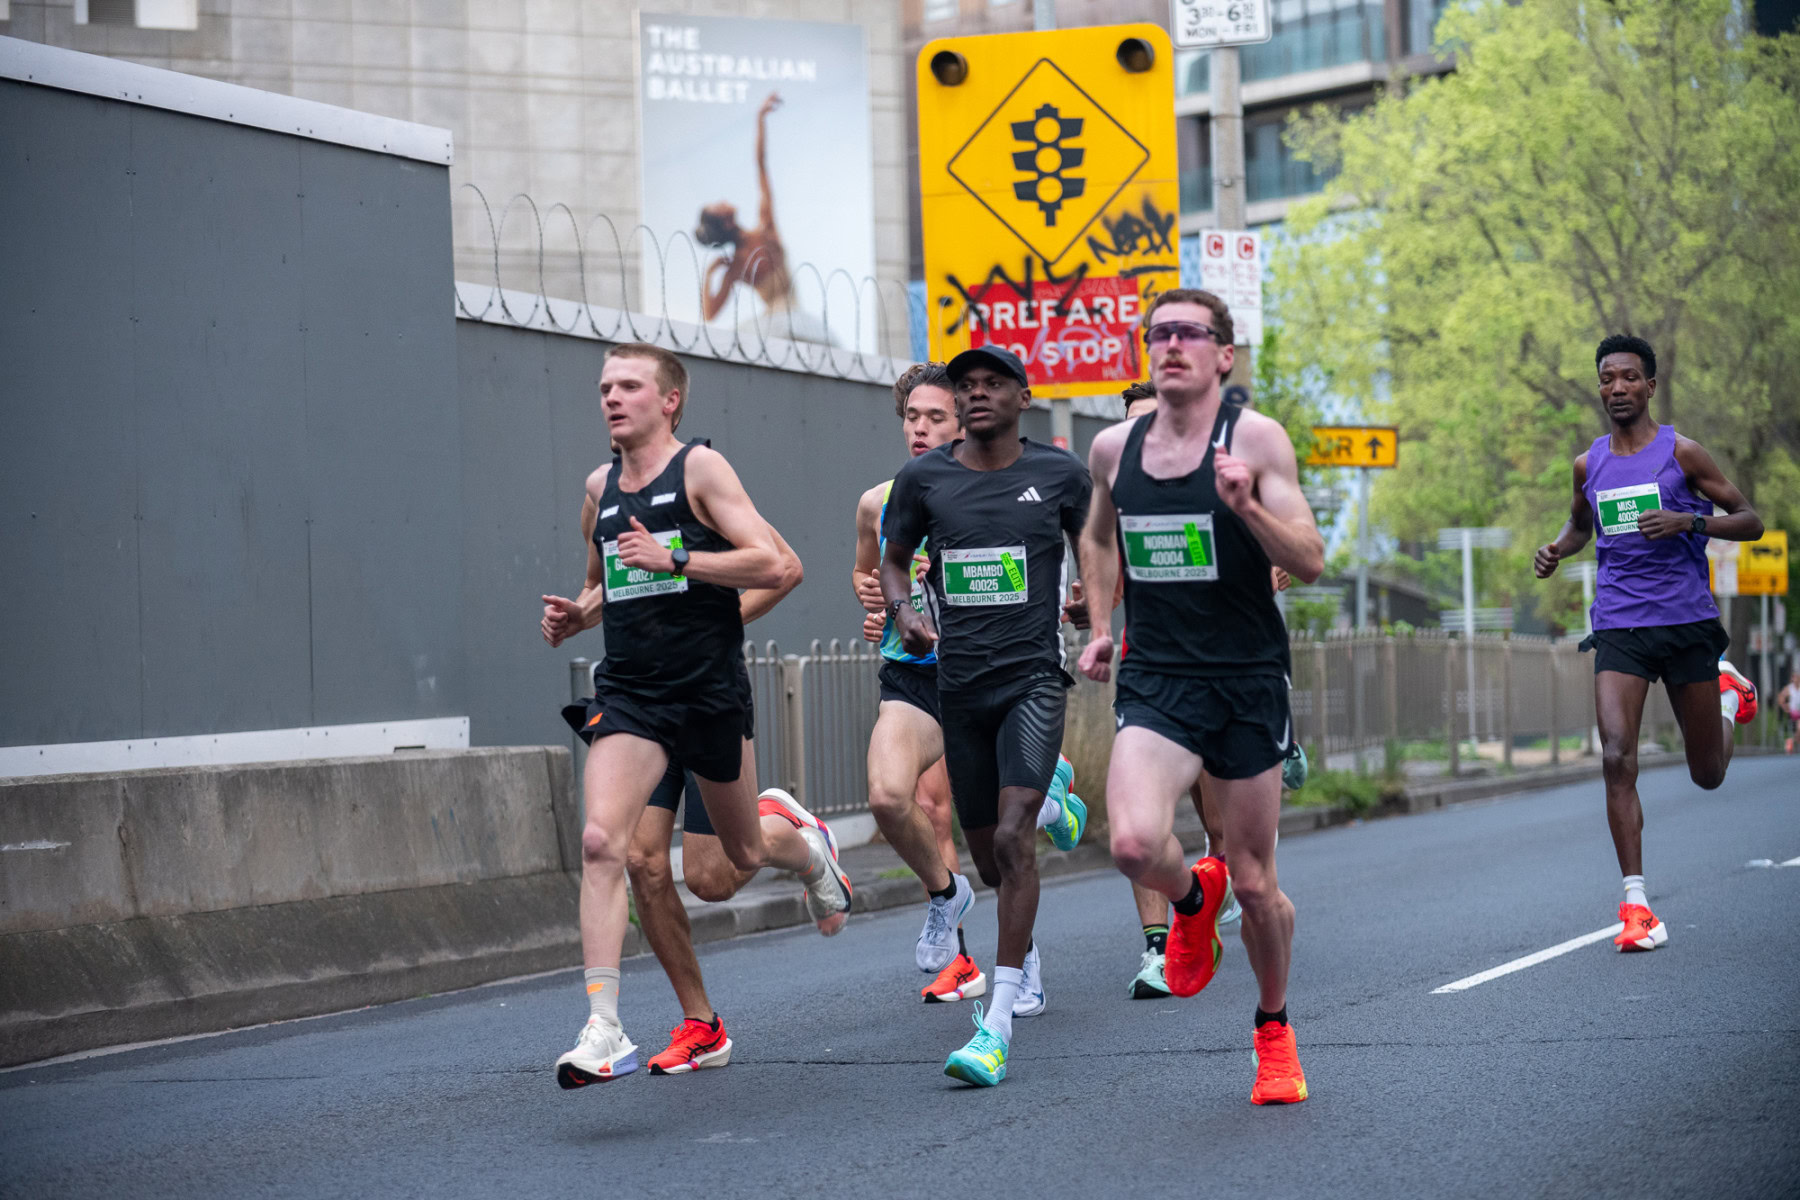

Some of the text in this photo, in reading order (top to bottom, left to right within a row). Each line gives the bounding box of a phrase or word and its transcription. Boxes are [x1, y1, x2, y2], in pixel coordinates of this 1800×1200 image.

[647, 24, 700, 50] THE
[1185, 27, 1217, 38] MON
[1235, 23, 1258, 34] FRI
[647, 52, 816, 82] AUSTRALIAN
[647, 77, 749, 104] BALLET
[1043, 337, 1122, 366] STOP
[1617, 499, 1637, 512] MUSA
[1617, 510, 1640, 523] 40036
[1143, 535, 1188, 550] NORMAN
[1150, 550, 1184, 565] 40004
[963, 564, 1003, 578] MBAMBO
[1135, 567, 1208, 578] MELBOURNE 2025
[969, 579, 999, 592] 40025
[1009, 567, 1024, 591] ELITE
[613, 581, 679, 598] MELBOURNE 2025
[952, 592, 1020, 603] MELBOURNE 2025
